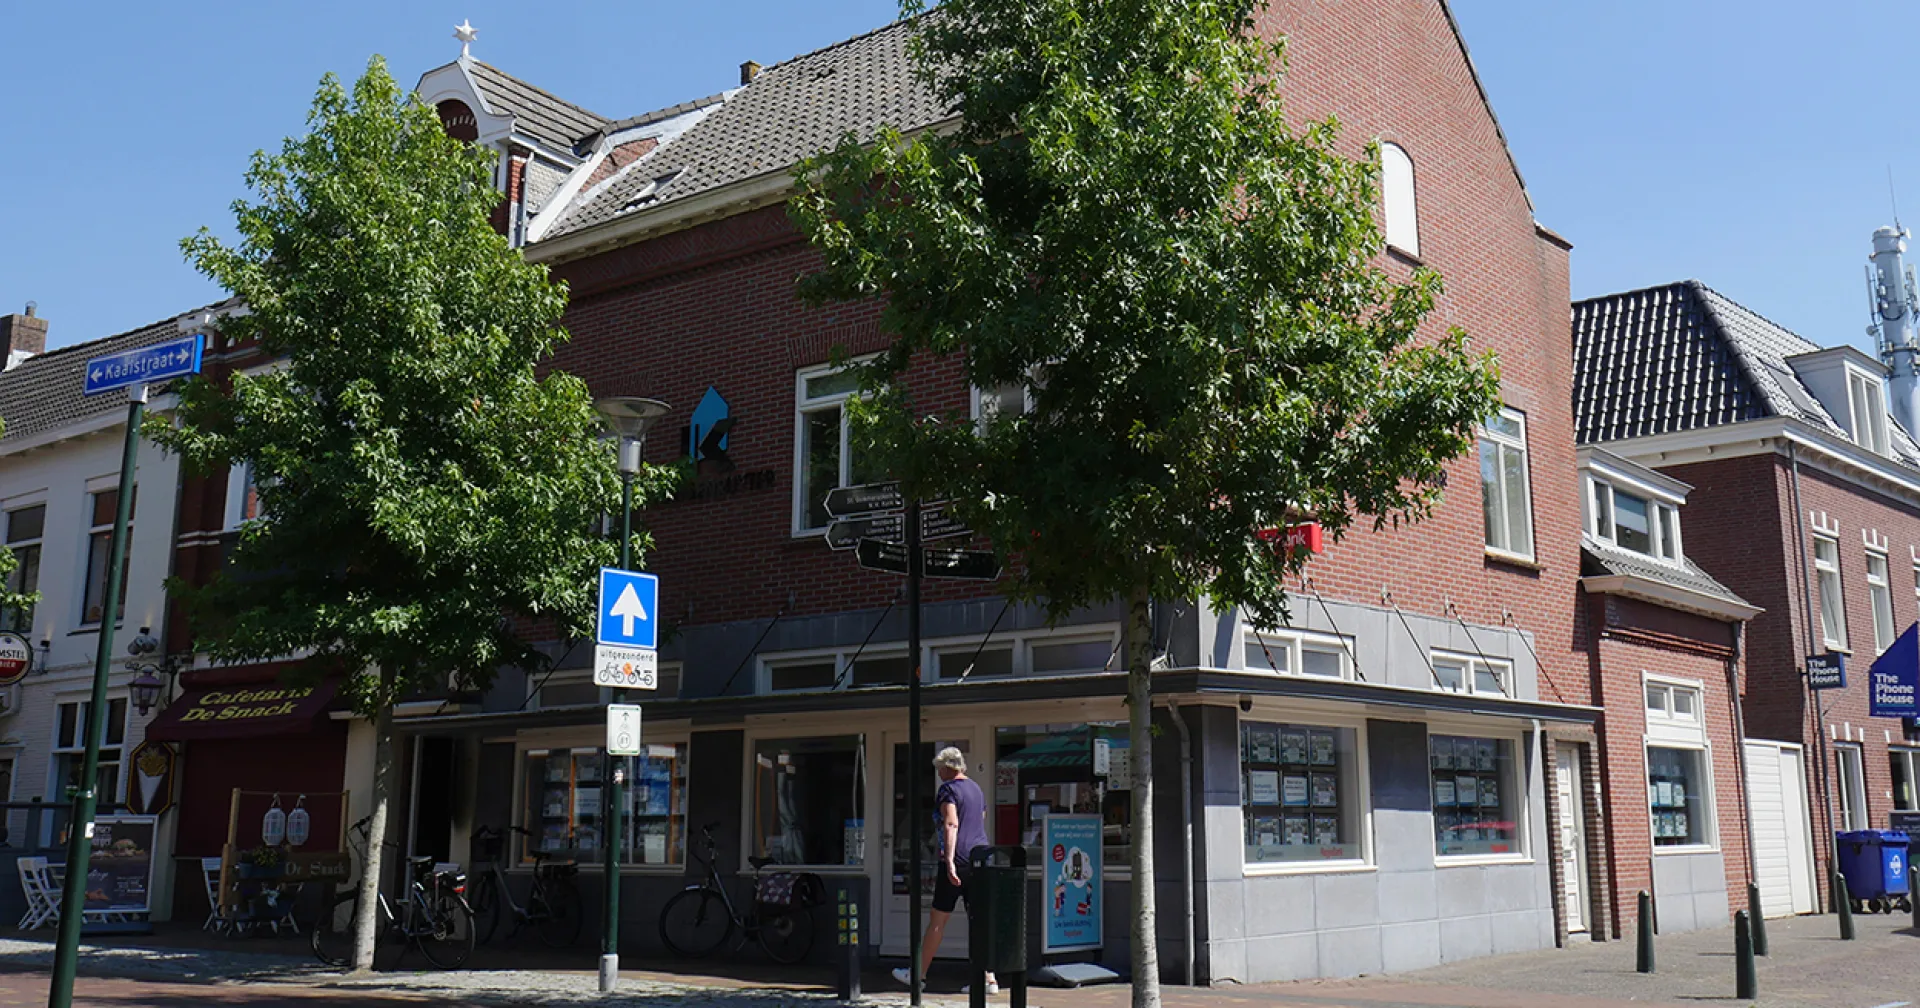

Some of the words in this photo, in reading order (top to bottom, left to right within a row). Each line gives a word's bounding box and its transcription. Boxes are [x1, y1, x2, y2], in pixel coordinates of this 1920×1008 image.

[601, 649, 654, 662] uitgezonderd
[1809, 667, 1840, 676] Phone
[1810, 675, 1840, 684] House
[1874, 673, 1899, 683] The
[1876, 683, 1915, 694] Phone
[1876, 694, 1915, 704] House
[179, 707, 215, 721] De
[216, 701, 299, 720] Snack
